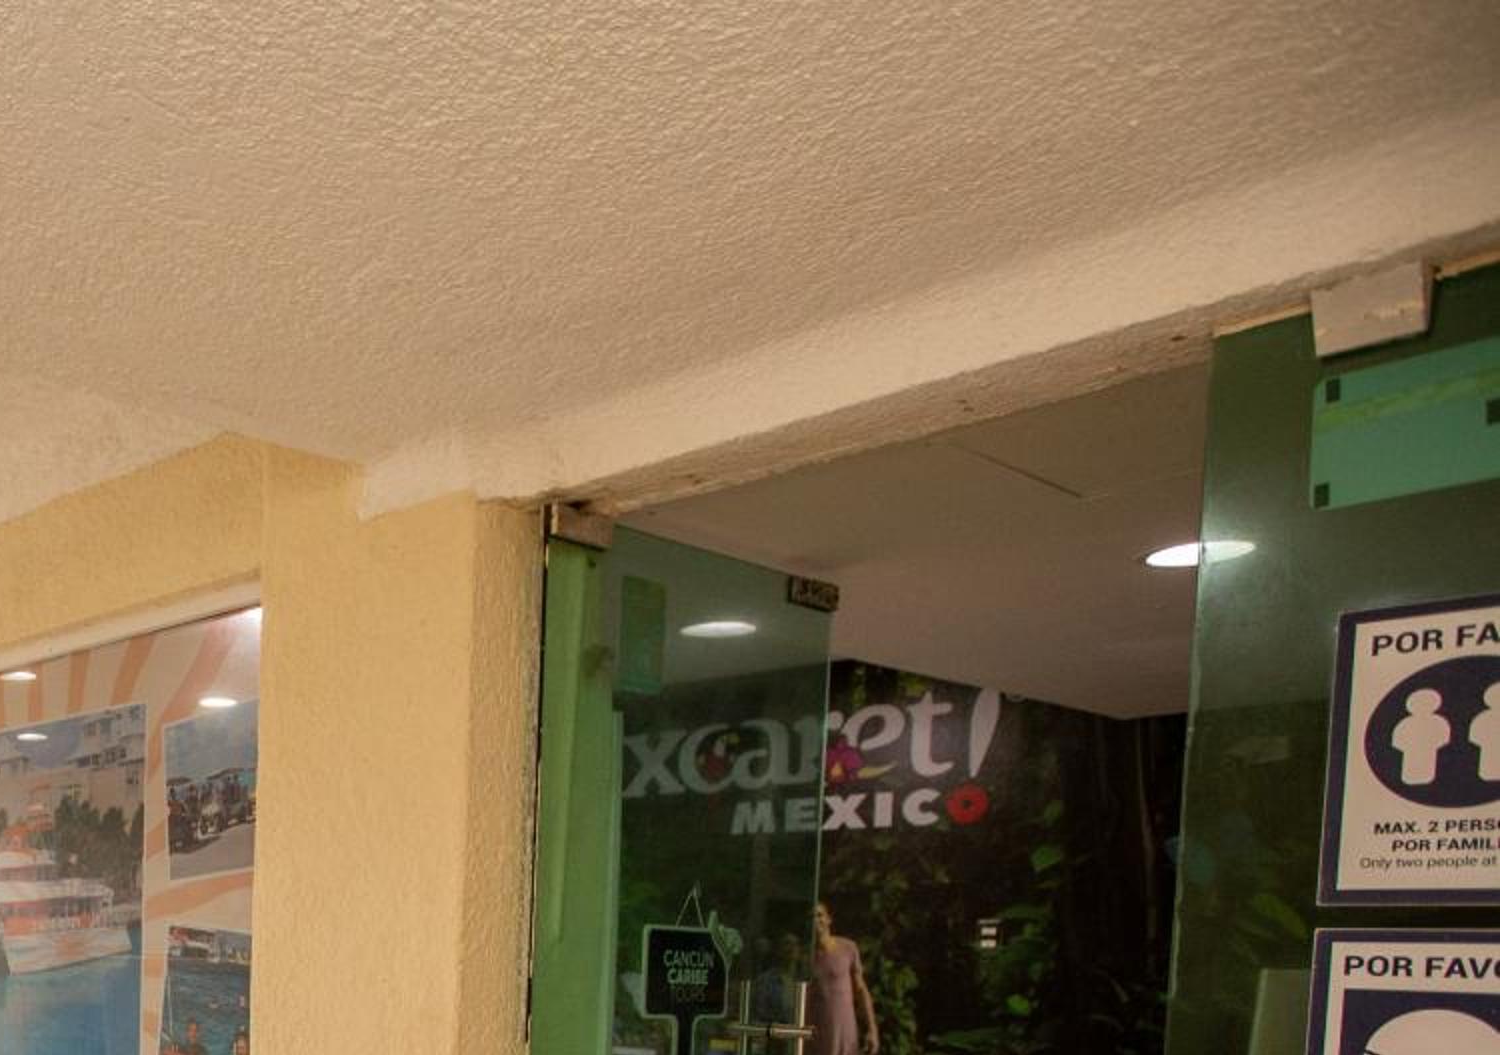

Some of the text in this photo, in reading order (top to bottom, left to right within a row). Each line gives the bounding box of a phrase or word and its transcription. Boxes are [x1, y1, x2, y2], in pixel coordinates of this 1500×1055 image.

[1371, 629, 1443, 656] POR
[1373, 818, 1500, 835] MAX. 2 PERS
[1391, 839, 1431, 852] POR
[1360, 855, 1497, 870] Only two people at
[1344, 955, 1413, 977] POR
